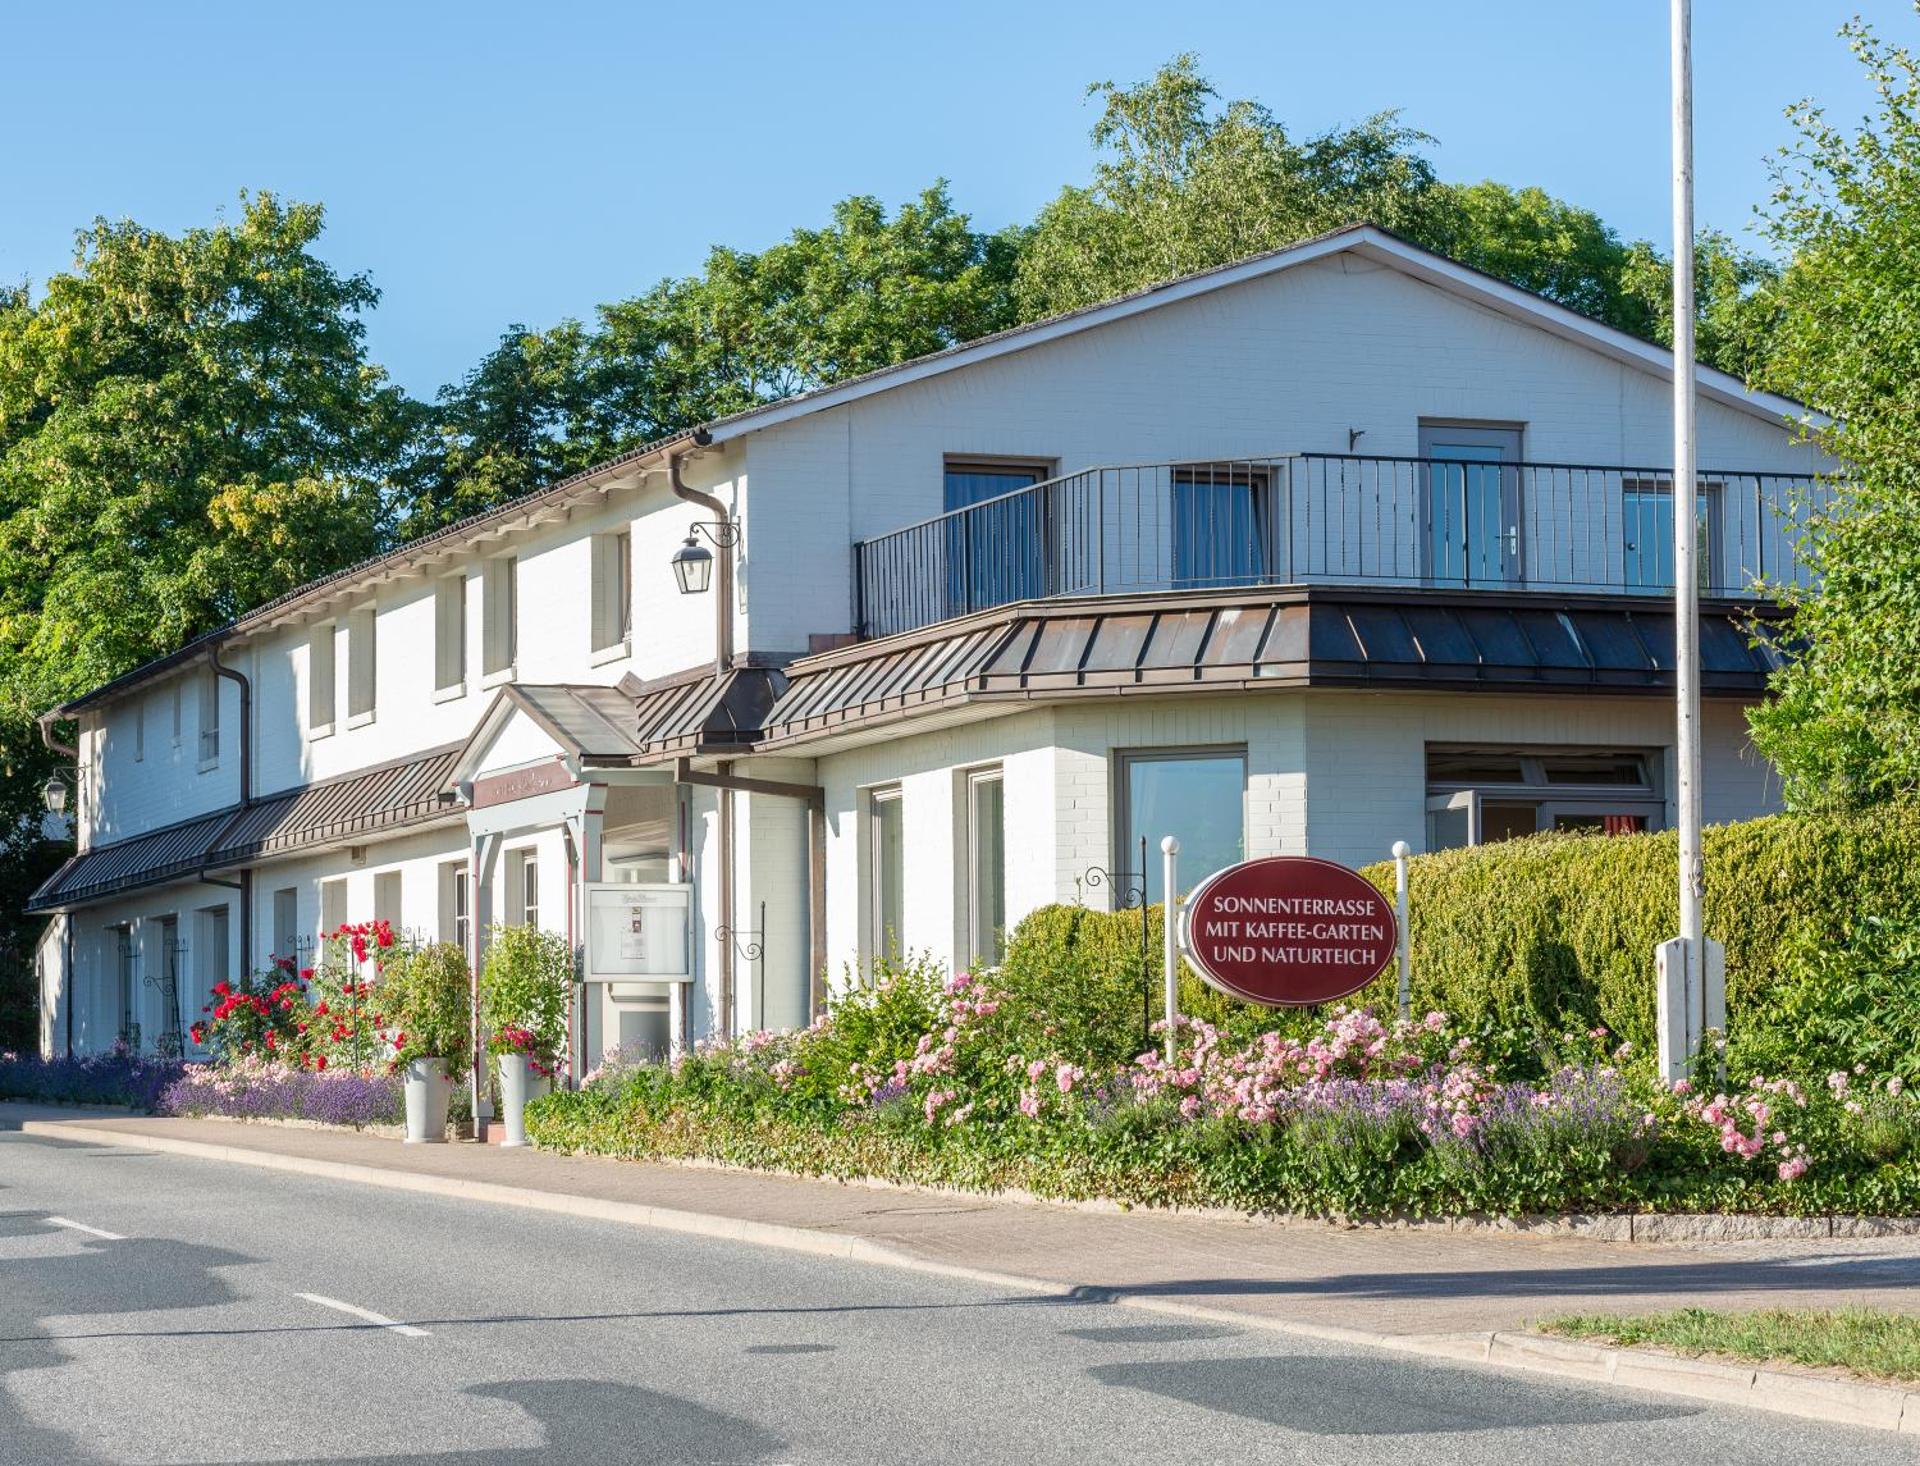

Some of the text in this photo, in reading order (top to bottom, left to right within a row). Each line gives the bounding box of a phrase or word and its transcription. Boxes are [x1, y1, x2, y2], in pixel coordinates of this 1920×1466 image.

[1213, 896, 1376, 916] SONNENTERRASSE
[1205, 921, 1384, 941] MIT KAFFEE-GARTEN
[1213, 946, 1376, 965] UND NATURTEICH
